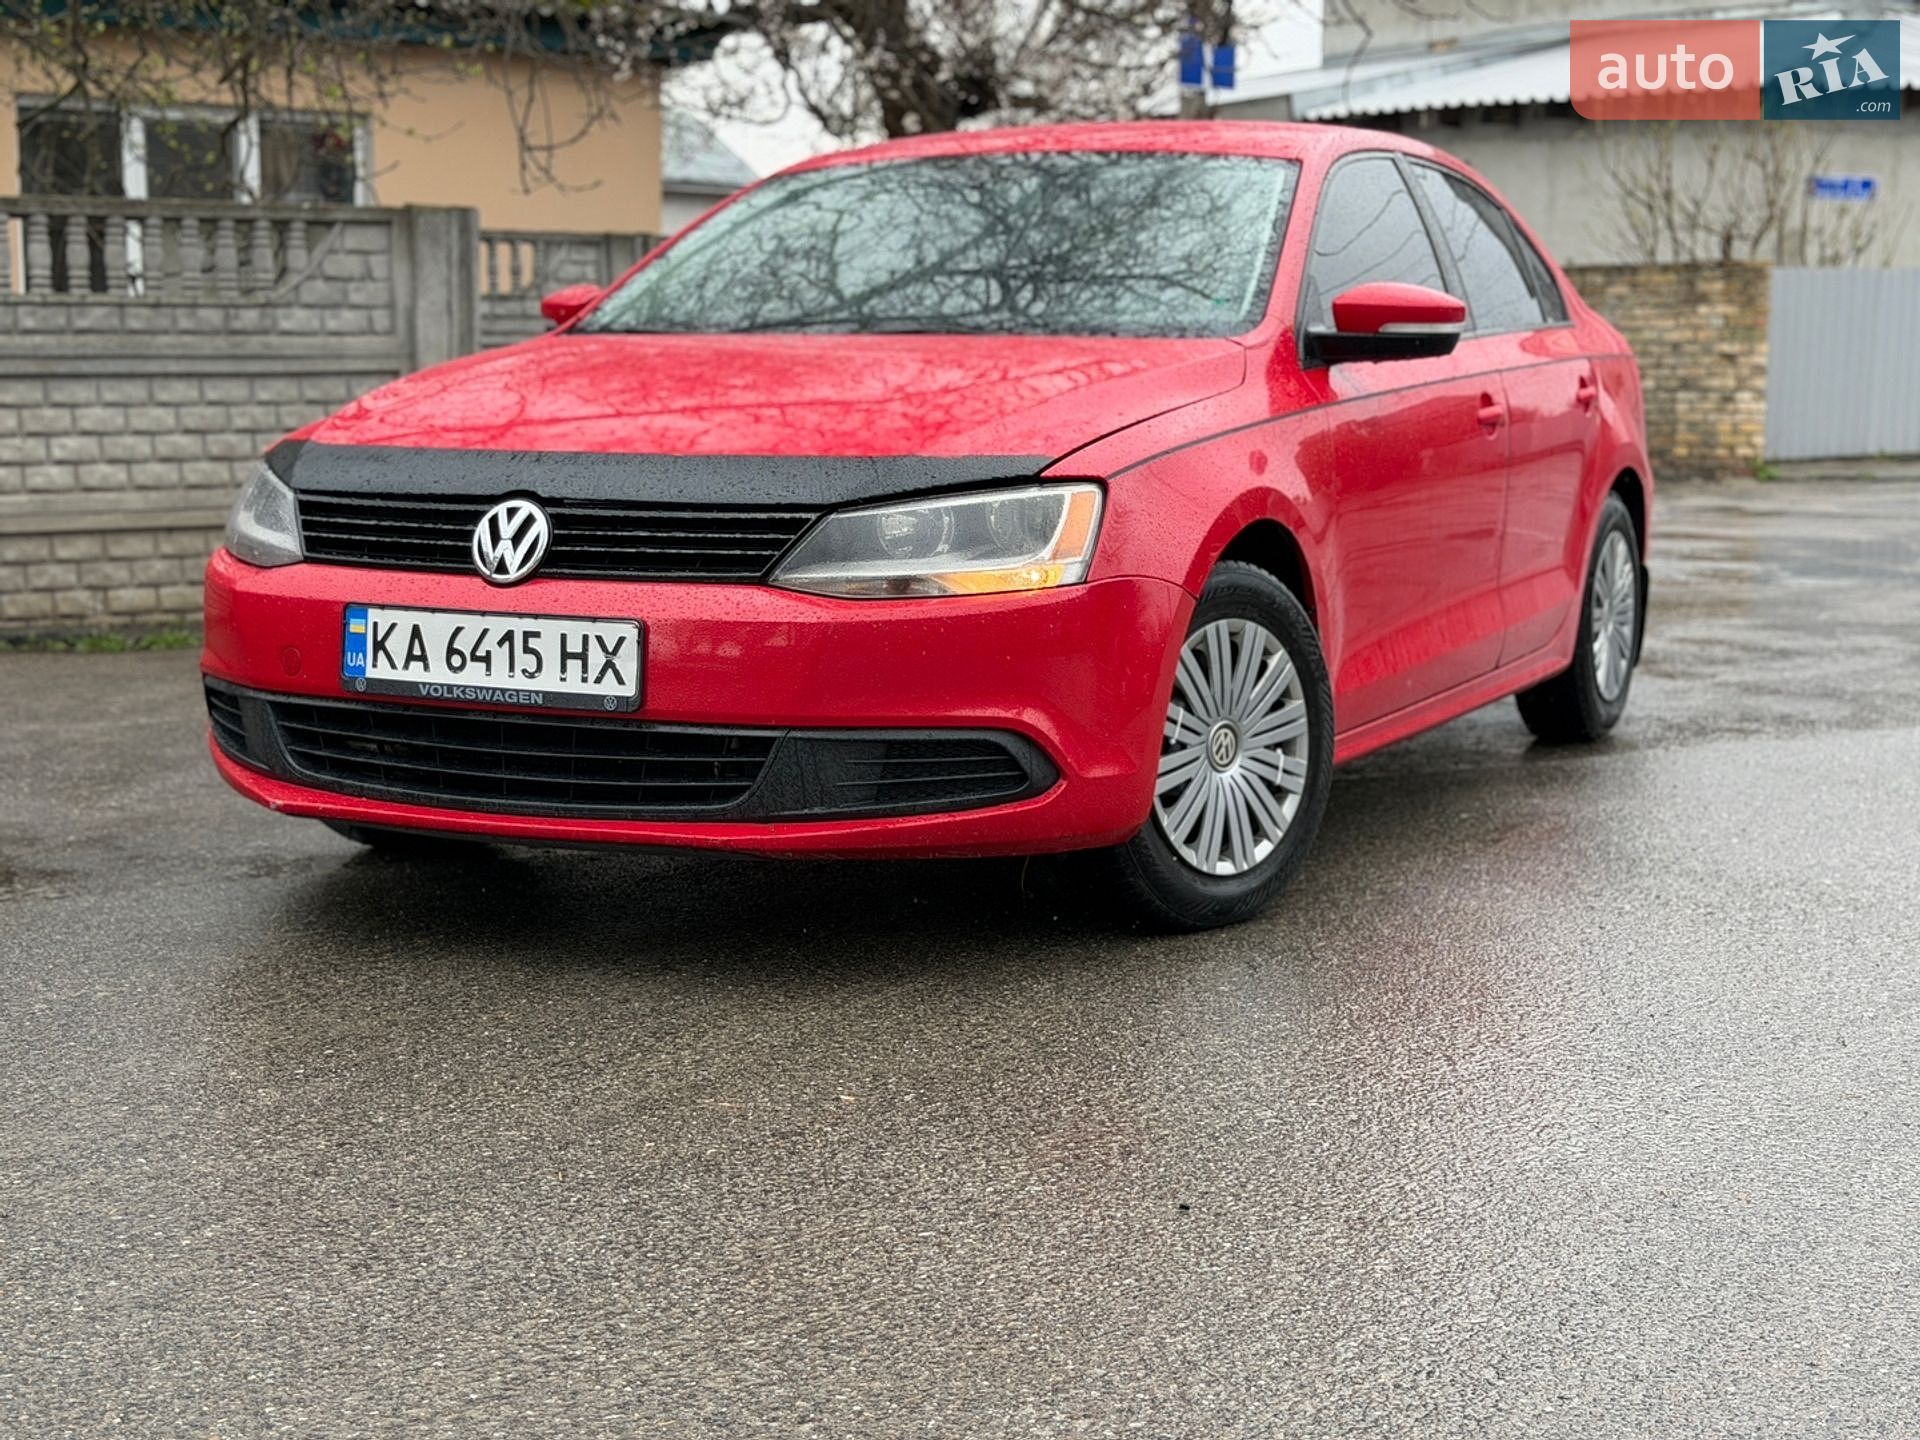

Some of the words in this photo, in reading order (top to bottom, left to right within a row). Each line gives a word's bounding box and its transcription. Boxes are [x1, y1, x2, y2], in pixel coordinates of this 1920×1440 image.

[347, 652, 365, 667] UA
[371, 620, 431, 673] KA
[445, 625, 544, 679] 6415
[559, 633, 627, 686] HX
[418, 683, 544, 704] VOLKSWAGEN
